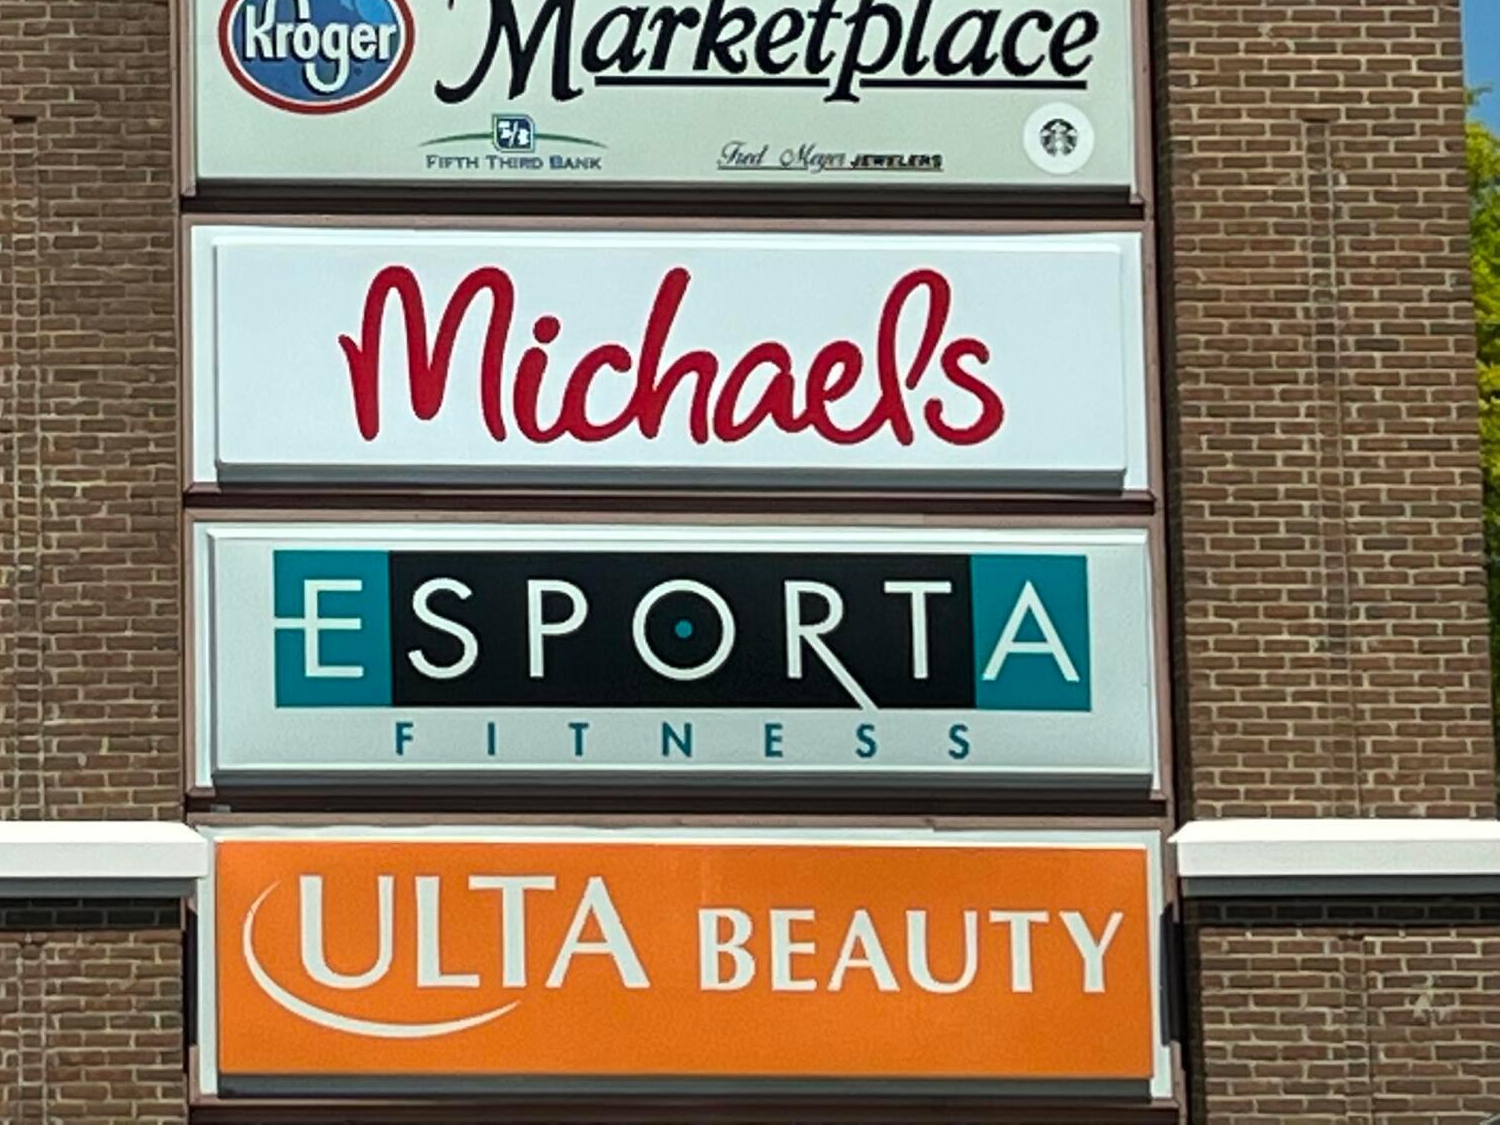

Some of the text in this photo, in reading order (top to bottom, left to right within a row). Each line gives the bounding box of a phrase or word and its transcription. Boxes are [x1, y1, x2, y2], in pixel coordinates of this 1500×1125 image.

[338, 265, 1005, 446] Michaels
[274, 576, 1080, 711] ESPORTA
[394, 720, 974, 760] FITNESS
[299, 875, 1125, 996] ULTA BEAUTY
